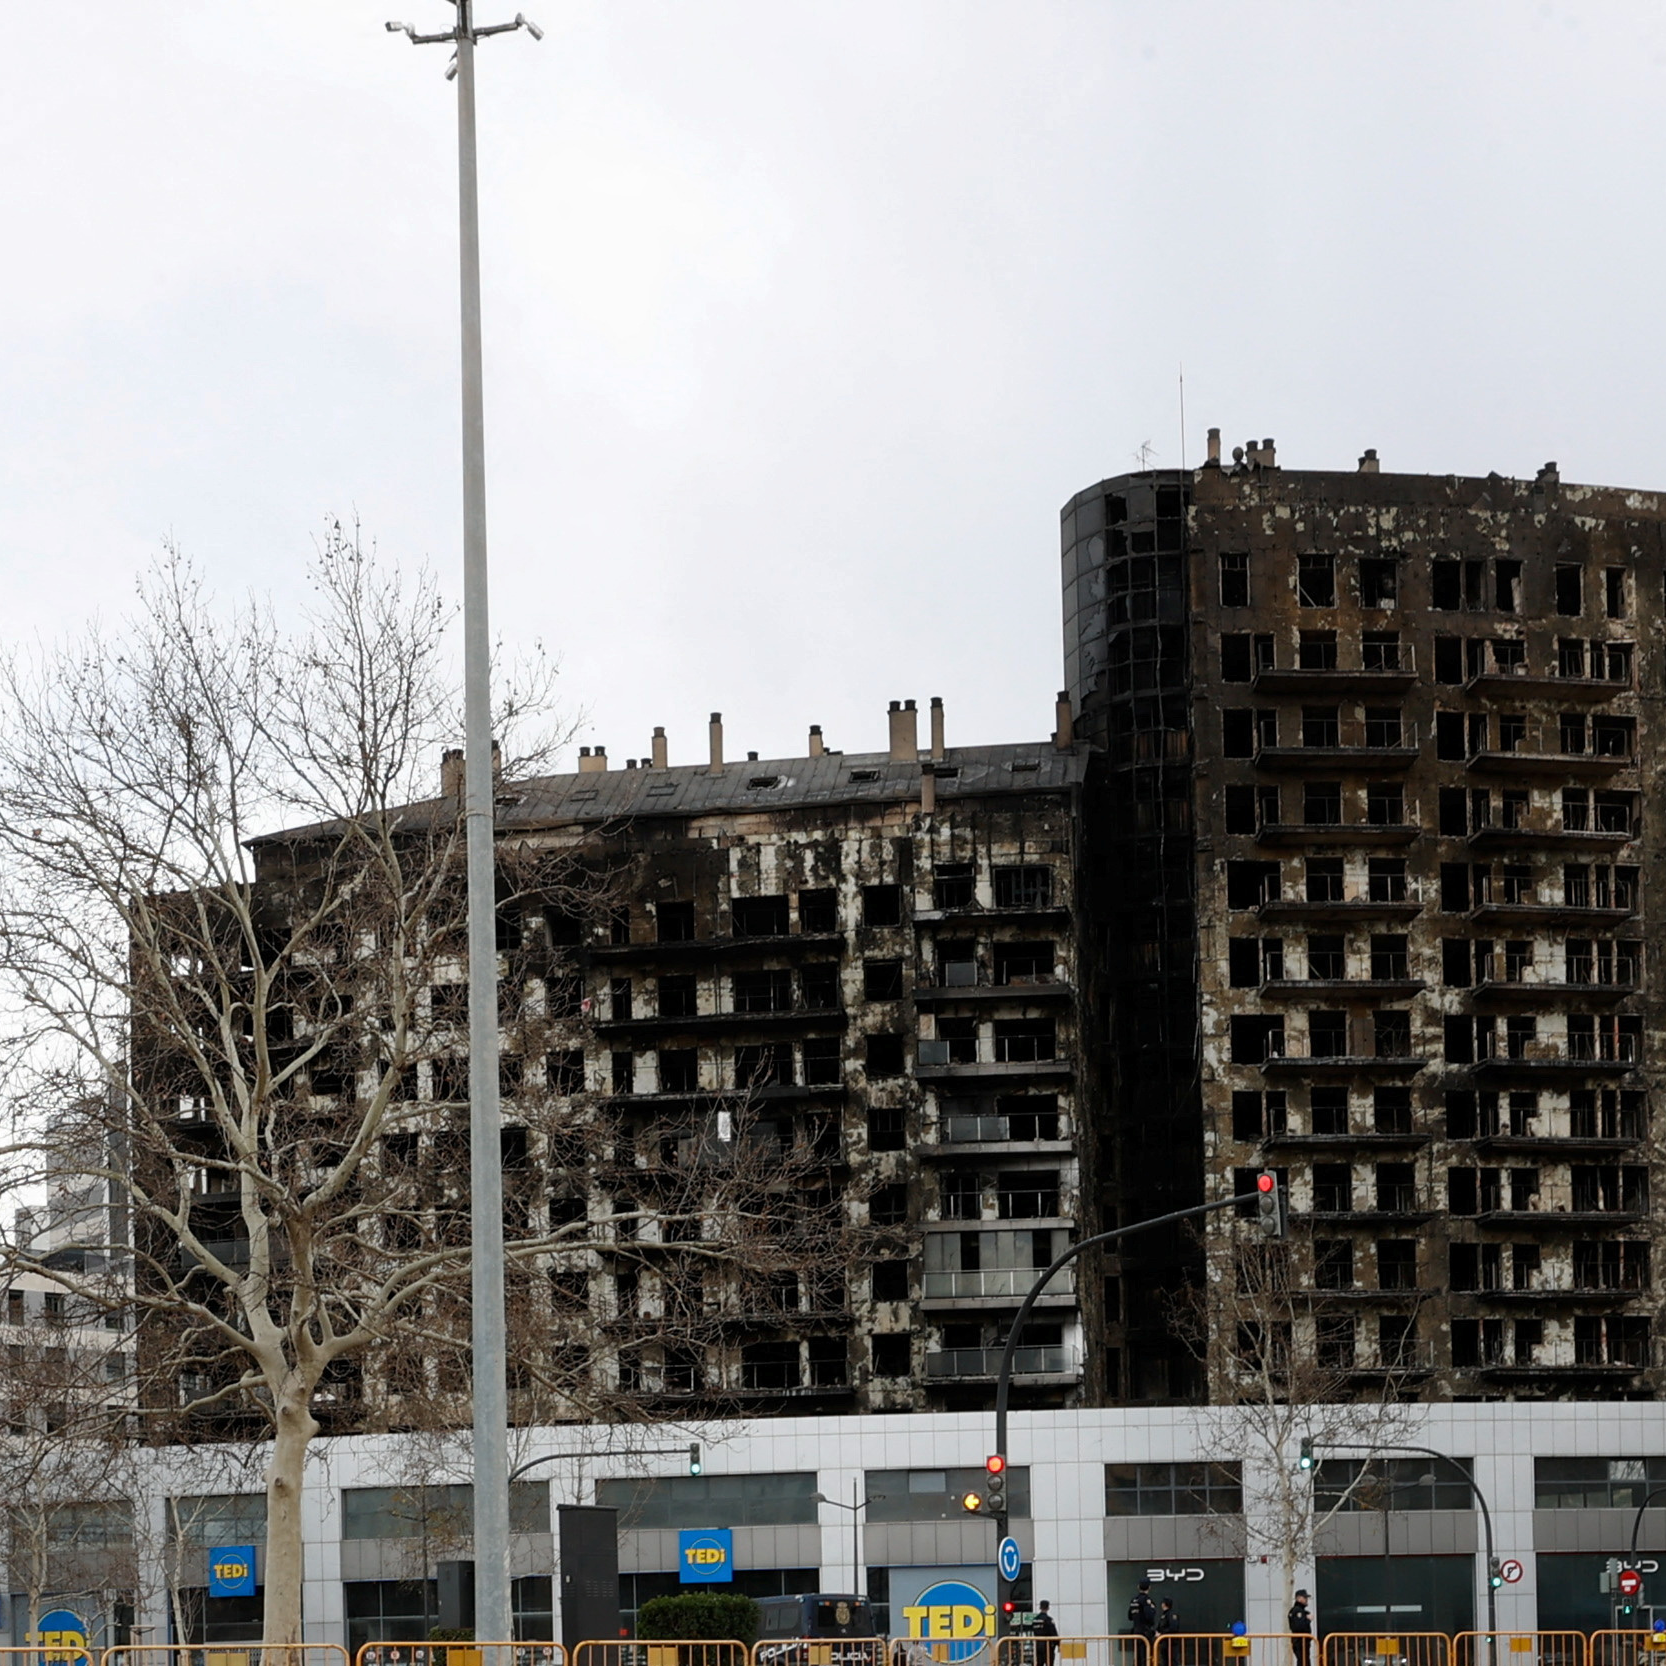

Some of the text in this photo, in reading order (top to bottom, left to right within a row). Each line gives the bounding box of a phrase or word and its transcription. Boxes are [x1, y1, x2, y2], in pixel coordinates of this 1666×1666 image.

[684, 1547, 726, 1565] TEDi
[213, 1562, 249, 1580] TEDi
[1146, 1568, 1205, 1582] BYD
[902, 1604, 997, 1639] TEDi
